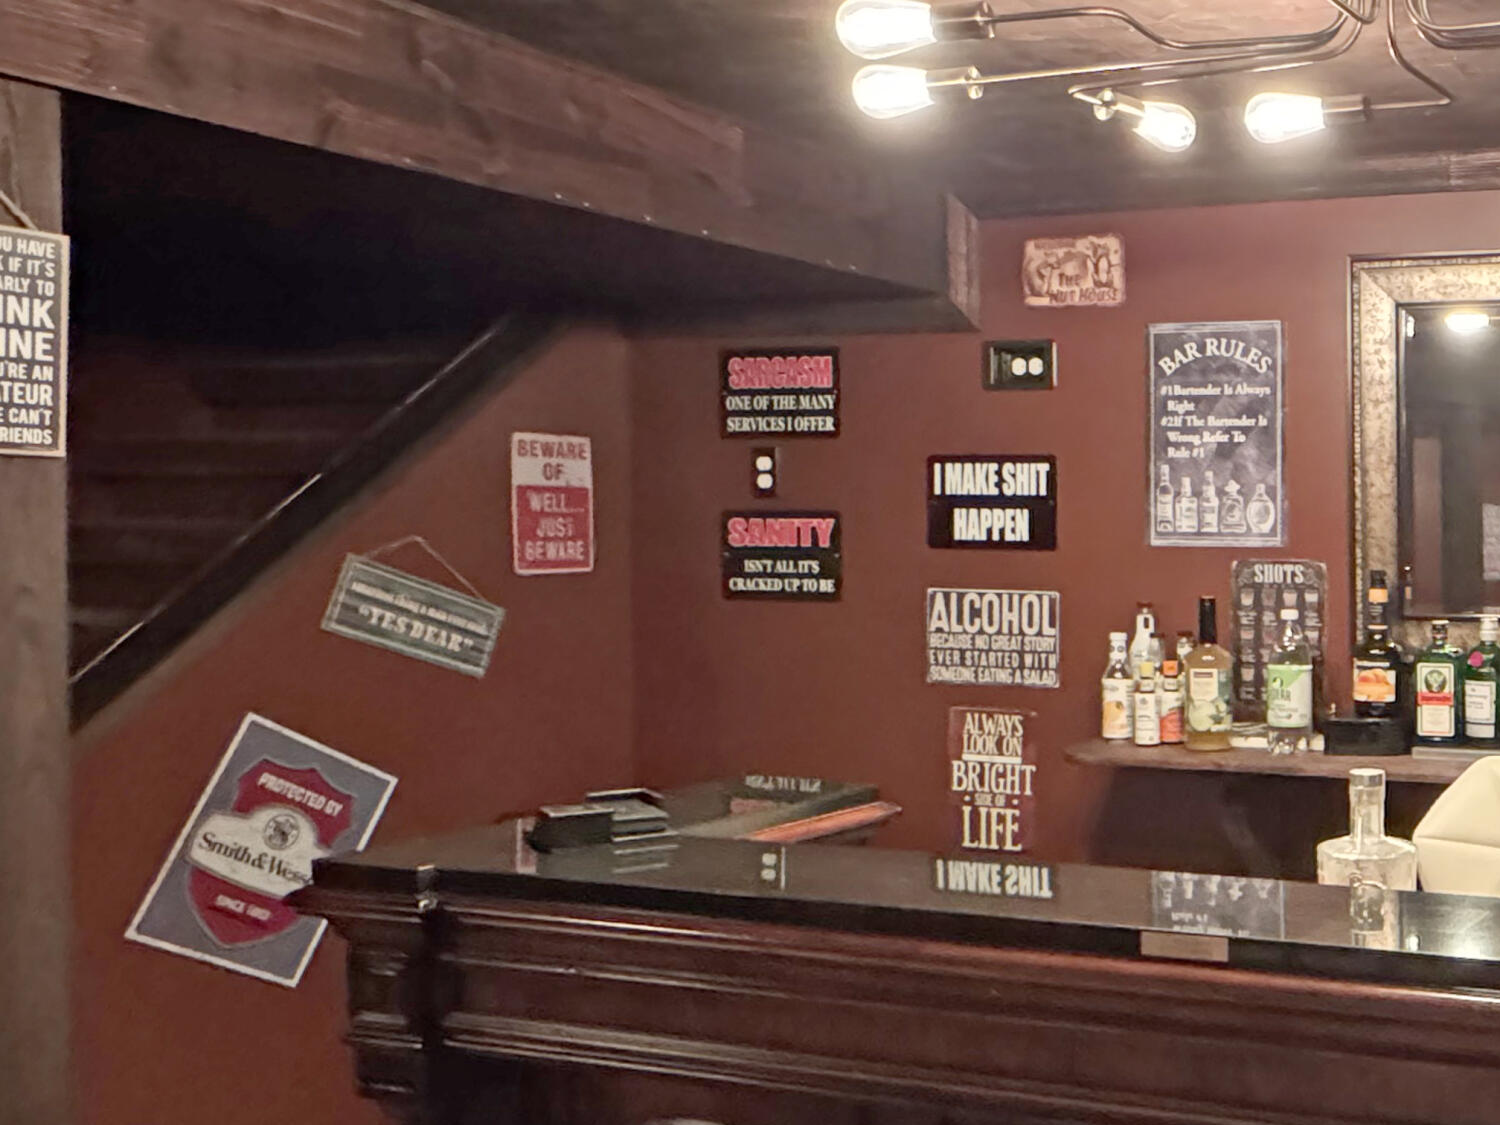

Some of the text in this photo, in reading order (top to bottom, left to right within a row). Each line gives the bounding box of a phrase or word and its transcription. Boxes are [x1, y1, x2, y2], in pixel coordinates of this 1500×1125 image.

[17, 238, 56, 259] HAVE
[9, 256, 23, 273] IF
[27, 259, 56, 278] IT'S
[37, 279, 55, 297] TO
[1158, 337, 1273, 376] BAR RULES
[31, 365, 53, 382] AN
[727, 355, 833, 389] SARCASM
[1174, 384, 1221, 396] Bartender
[1235, 382, 1271, 397] Always
[725, 394, 836, 411] ONE OF THE MANY
[1167, 400, 1195, 414] Right
[9, 407, 52, 426] CAN'T
[726, 415, 835, 432] SERVICES I OFFER
[1186, 415, 1205, 427] The
[1207, 414, 1256, 427] Bartender
[1166, 430, 1247, 446] Wrong Refer To
[517, 439, 588, 460] BEWARE
[1167, 447, 1190, 459] Rule
[542, 462, 566, 481] OF
[933, 462, 1050, 497] I MAKE SHIT
[536, 516, 574, 538] JUST
[727, 516, 836, 548] SANITY
[953, 507, 1030, 542] HAPPEN
[525, 540, 585, 561] BEWARE
[743, 559, 820, 574] ISN'T ALL IT'S
[1253, 563, 1305, 584] SHOTS
[728, 577, 836, 593] CRACKED UP TO BE
[929, 591, 1056, 635] ALCOHOL
[930, 633, 1056, 651] BECAUSE NO GREAT STORY
[930, 650, 1056, 669] EVER STARTED WITH
[930, 665, 1056, 685] SOMEONE EATING A SALAD
[963, 711, 1024, 737] ALWAYS
[962, 734, 1023, 757] LOOK ON
[951, 760, 1037, 796] BRIGHT
[257, 772, 344, 817] PROTECTED BY
[961, 805, 1023, 852] LIFE
[198, 831, 252, 865] Smith
[251, 852, 268, 870] &
